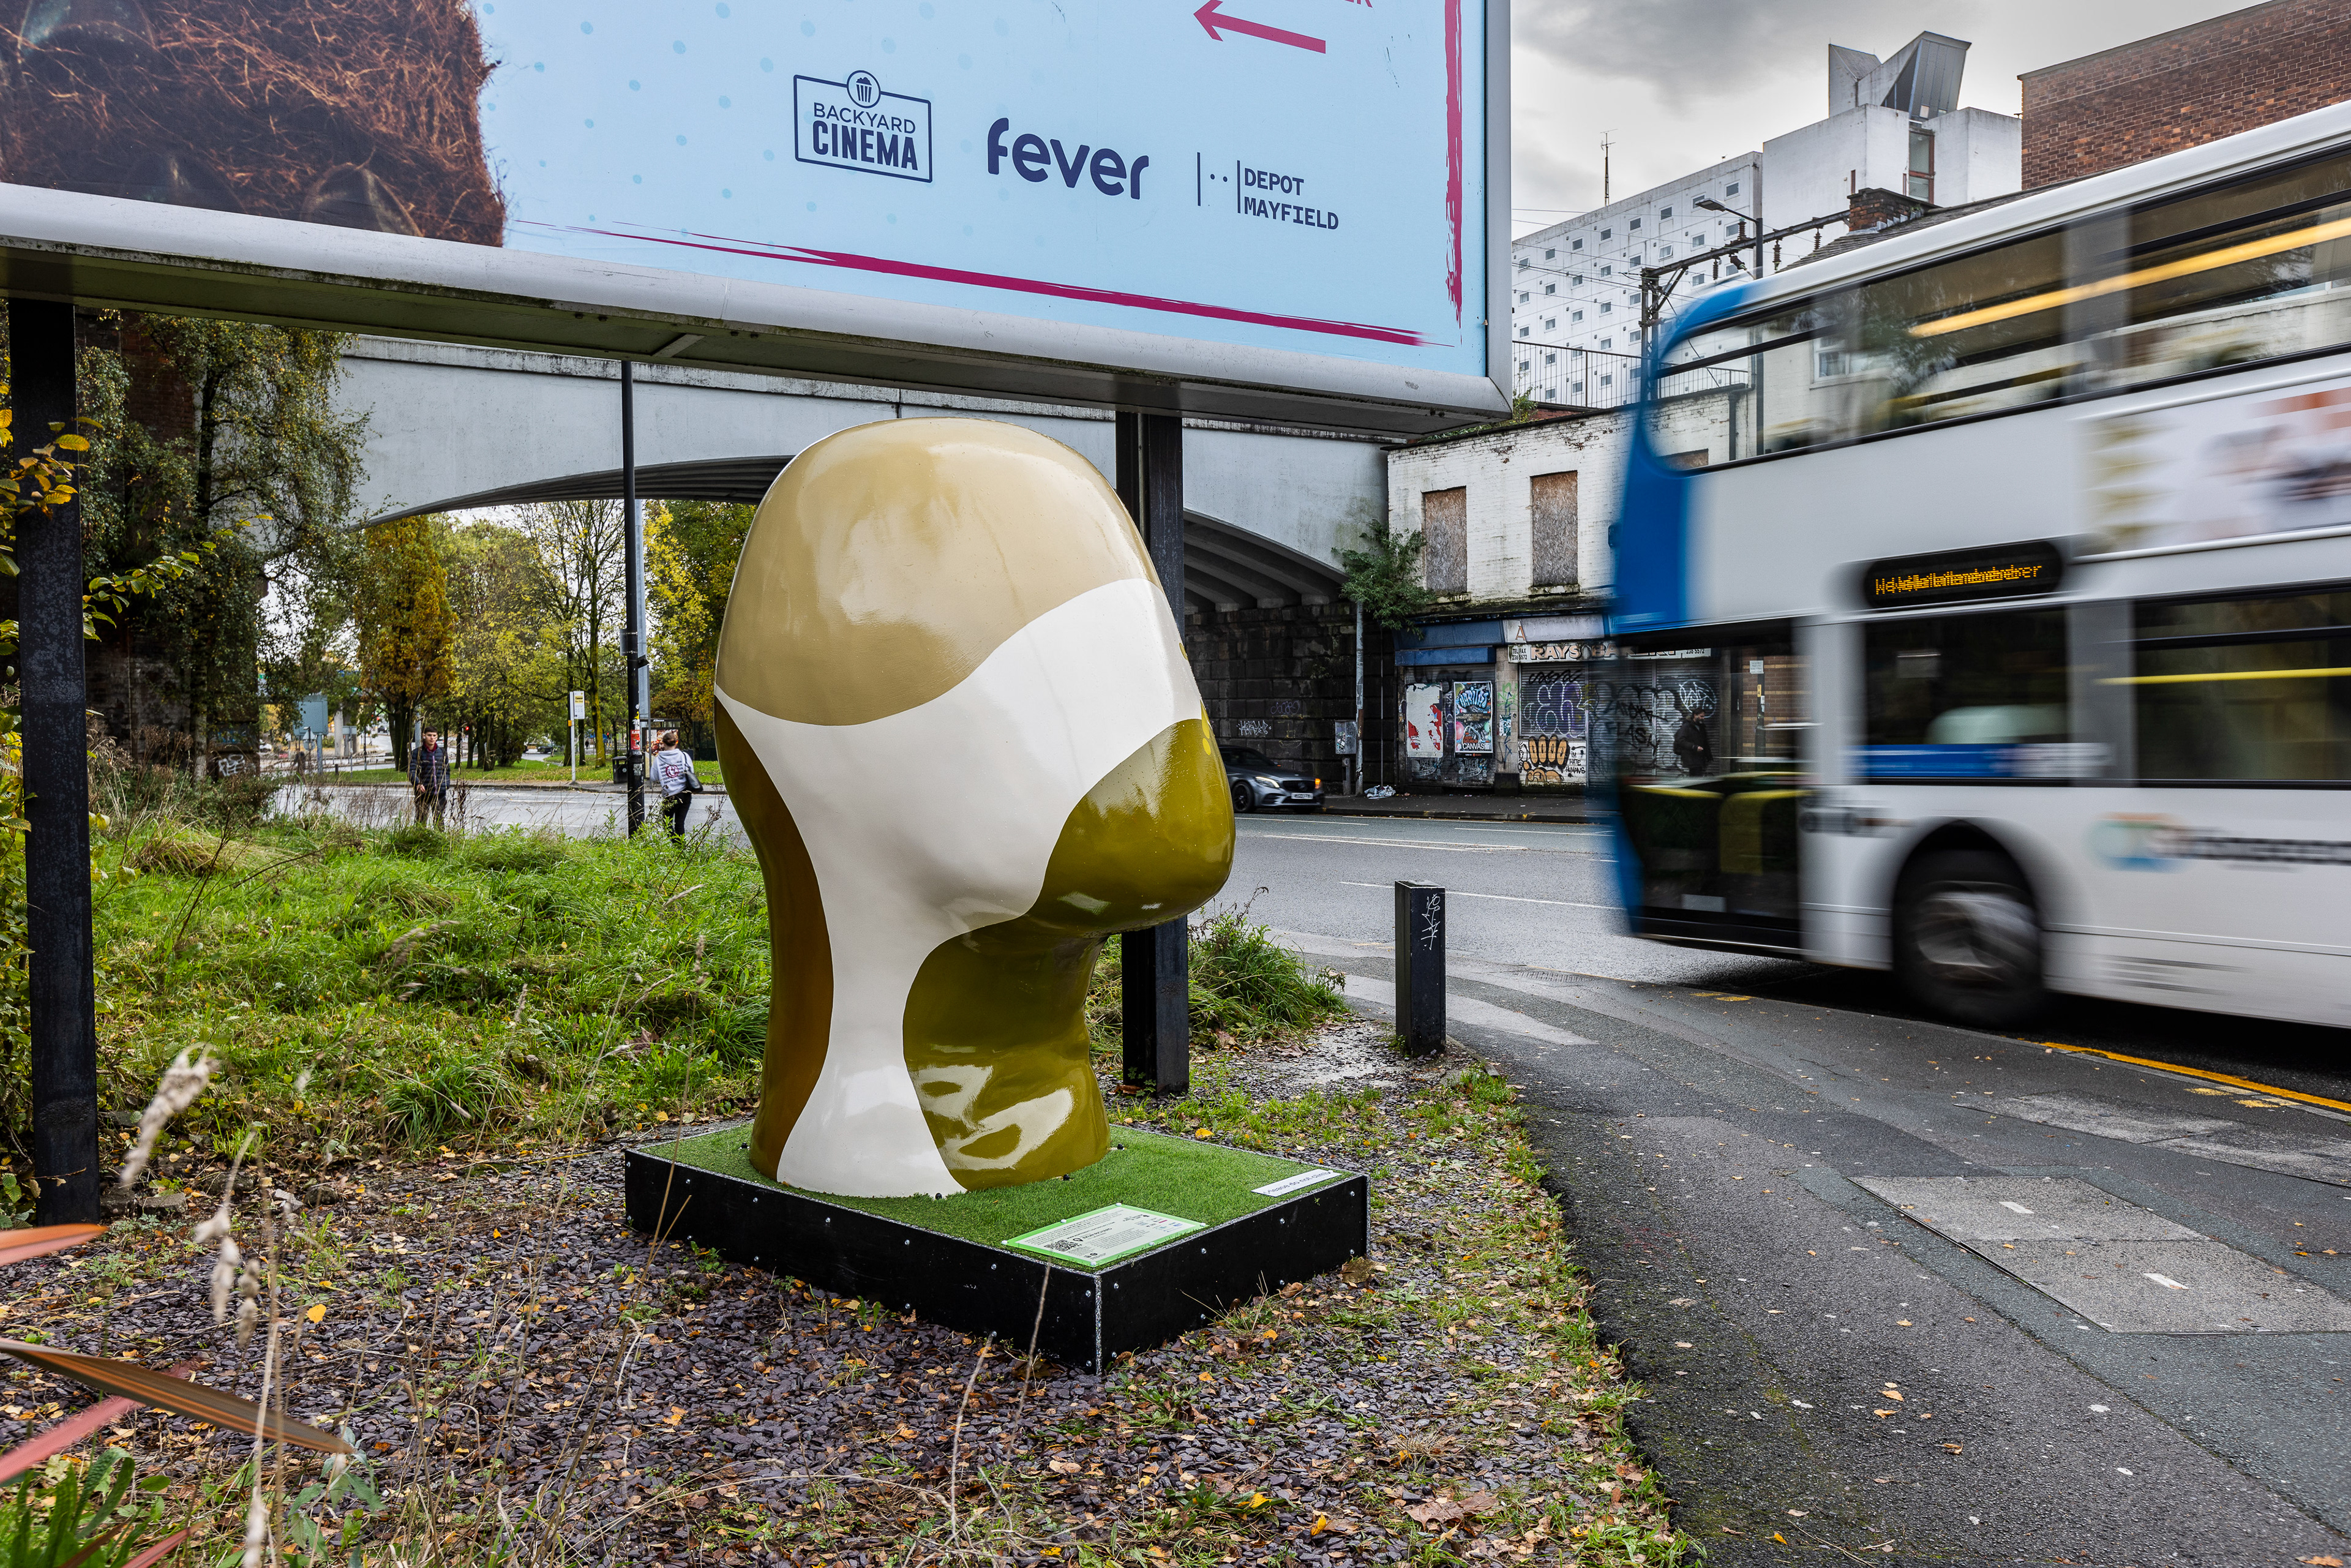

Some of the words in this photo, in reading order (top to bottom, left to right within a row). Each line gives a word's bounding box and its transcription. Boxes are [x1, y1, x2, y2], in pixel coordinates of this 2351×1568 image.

[814, 102, 916, 134] BACKYARD
[812, 120, 918, 171] CINEMA
[988, 117, 1149, 200] fever
[1244, 167, 1304, 196] DEPOT
[1244, 196, 1339, 230] MAYFIELD
[1531, 645, 1581, 660] RAYS
